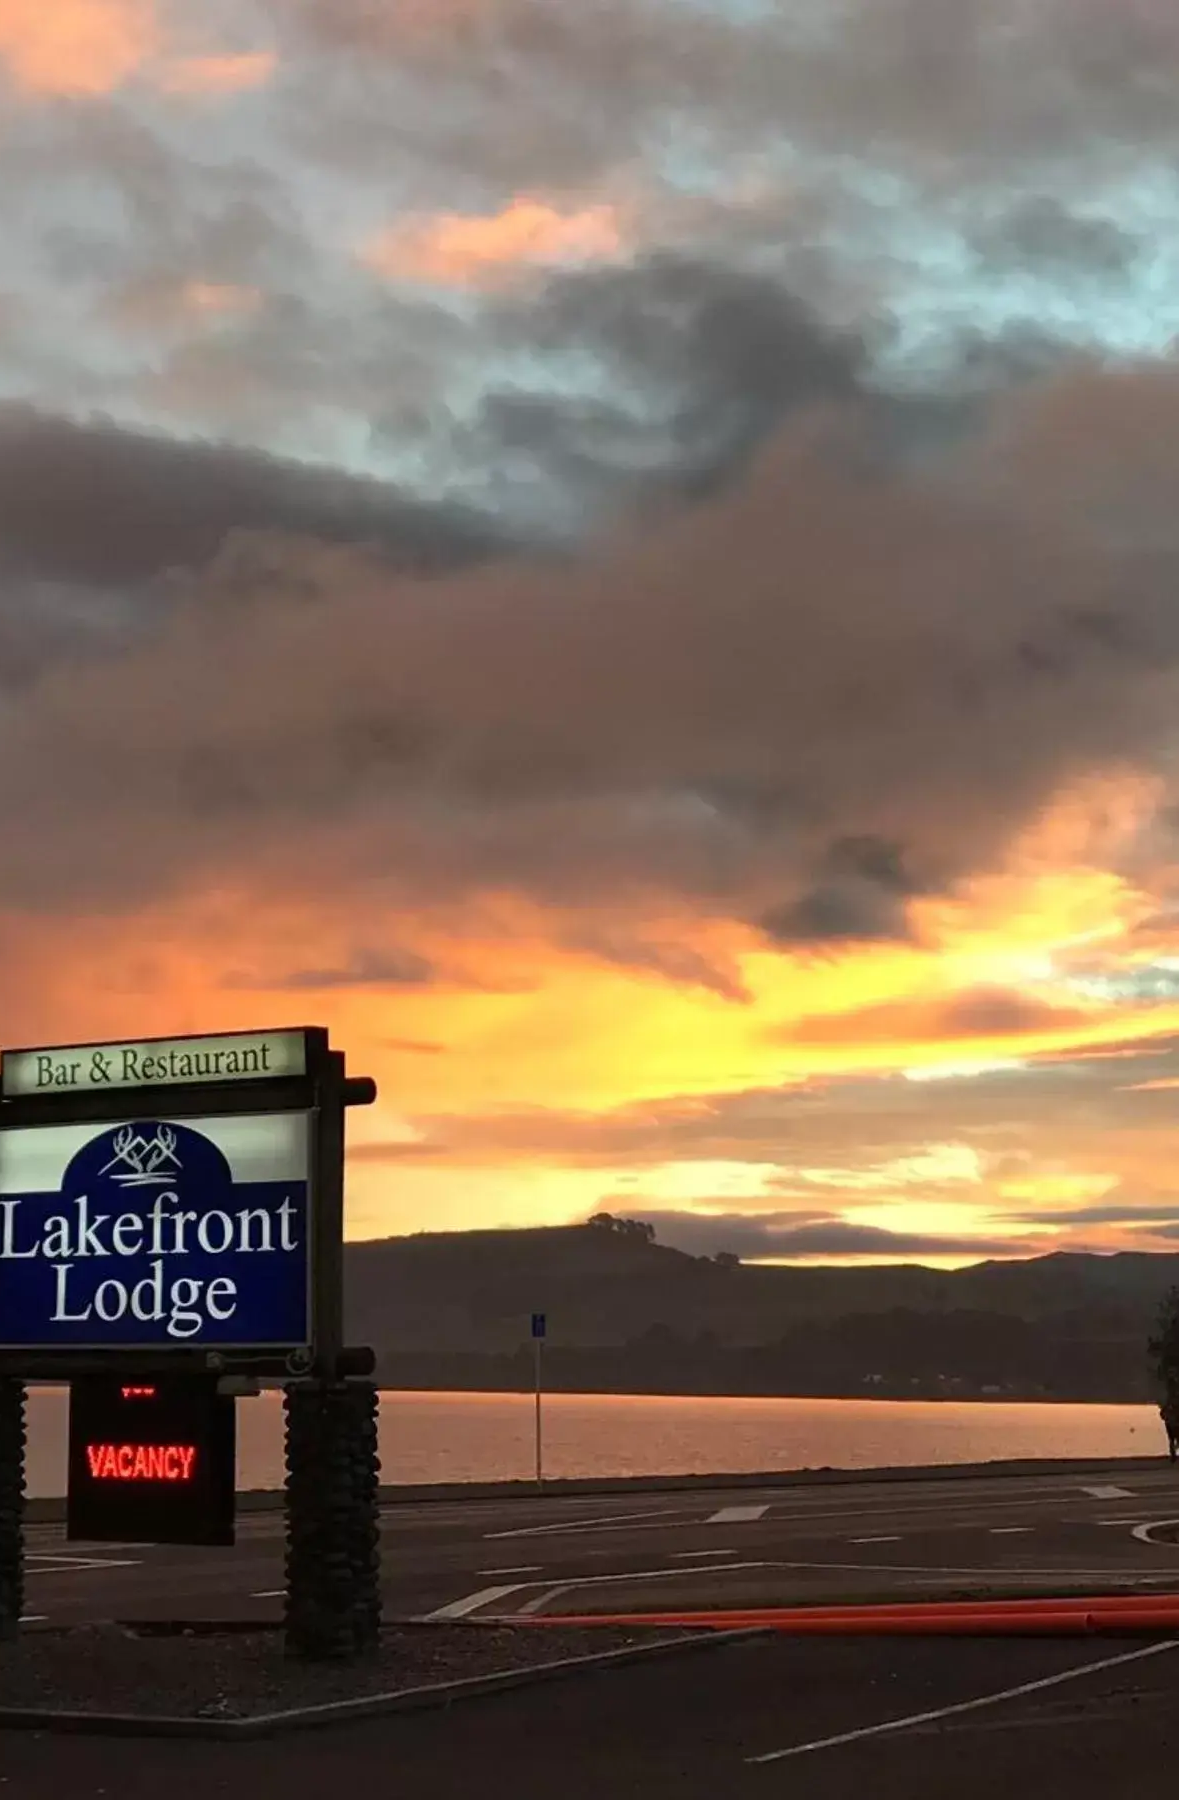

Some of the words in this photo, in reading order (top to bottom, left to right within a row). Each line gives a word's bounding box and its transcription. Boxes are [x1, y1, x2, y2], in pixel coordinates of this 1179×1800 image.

[36, 1055, 82, 1087] Bar
[90, 1051, 114, 1083] &
[122, 1043, 271, 1080] Restaurant
[49, 1259, 238, 1338] Lodge
[86, 1445, 196, 1480] VACANCY
